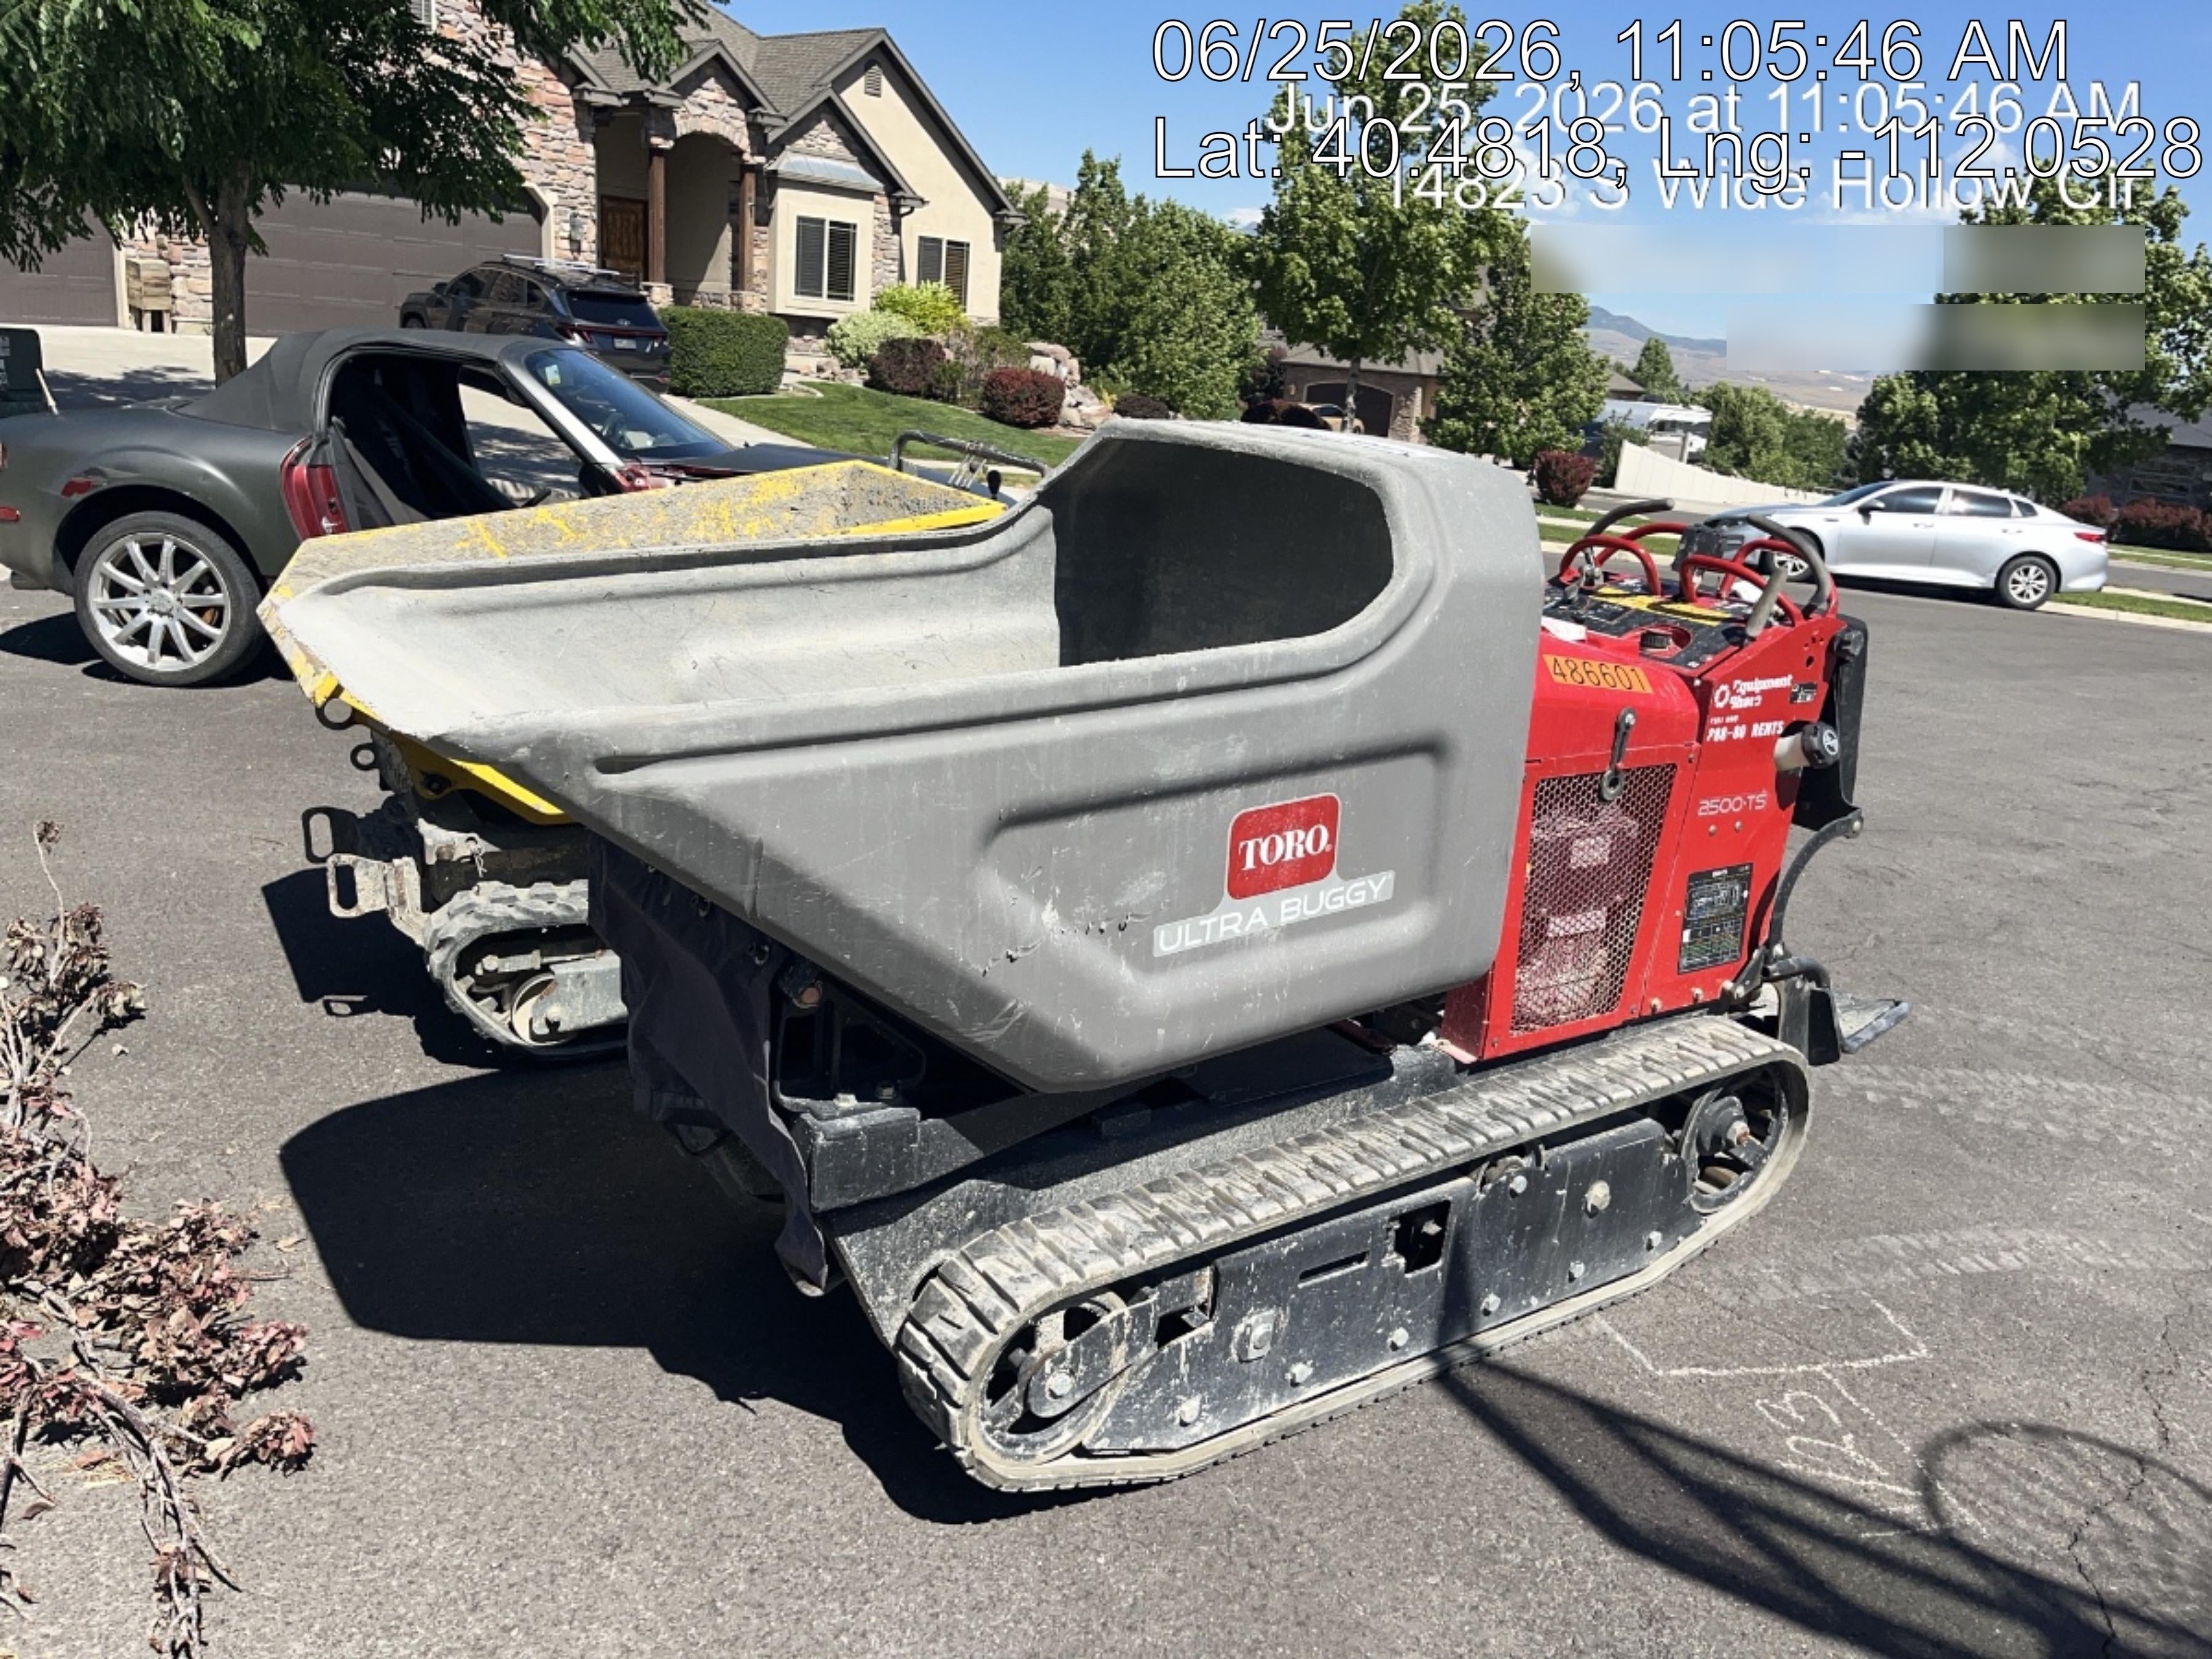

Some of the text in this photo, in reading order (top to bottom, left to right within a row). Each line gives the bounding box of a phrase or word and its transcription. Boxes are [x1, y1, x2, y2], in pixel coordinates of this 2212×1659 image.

[1553, 657, 1645, 691] 486601
[1159, 876, 1387, 952] ULTRA BUGGY
